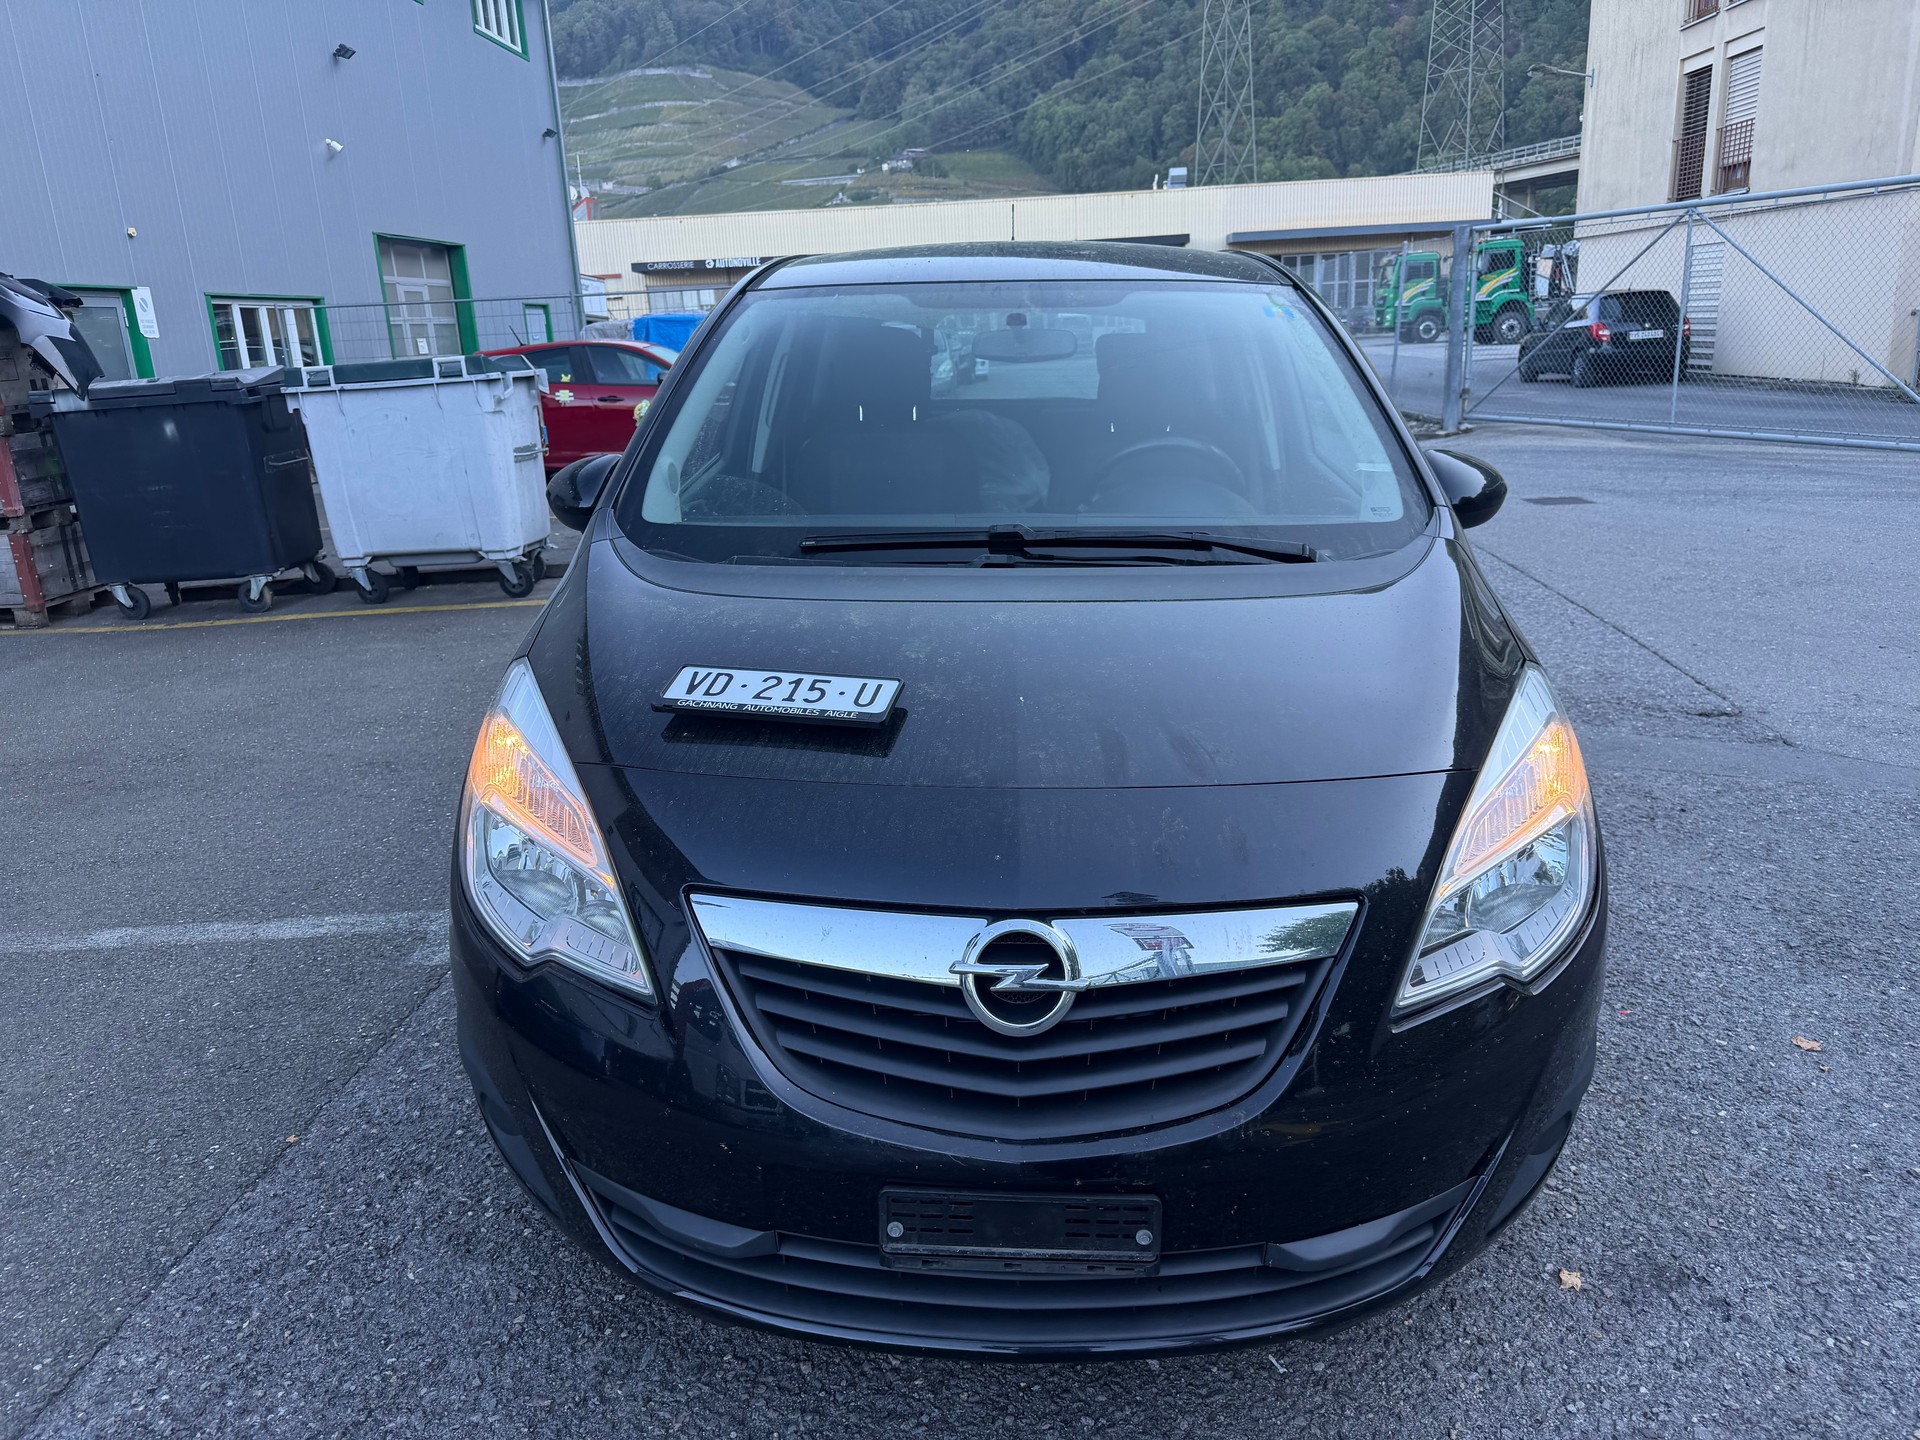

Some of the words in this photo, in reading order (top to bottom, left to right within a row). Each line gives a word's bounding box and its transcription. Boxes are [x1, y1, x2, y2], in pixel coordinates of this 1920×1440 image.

[647, 261, 695, 270] CARROSSERIE
[715, 257, 761, 268] AUTONOVILLE
[677, 699, 738, 710] GACHNANG
[743, 704, 820, 716] AUTOMOBILES
[824, 710, 859, 719] AIGLE
